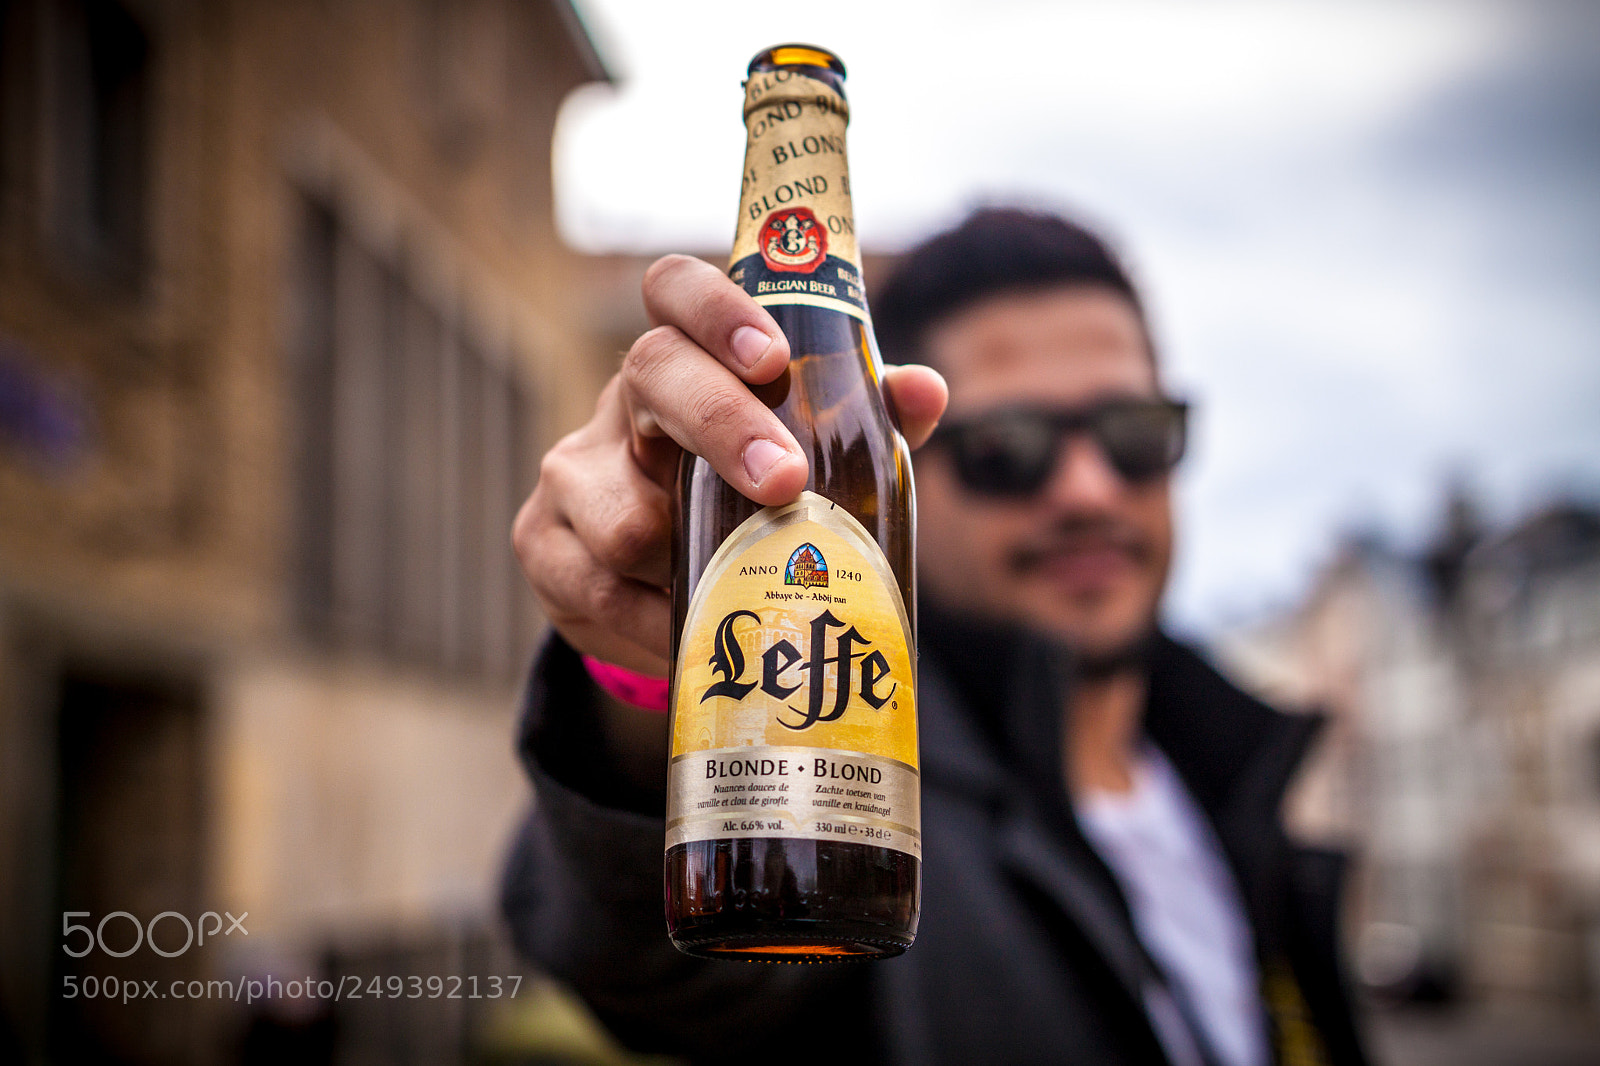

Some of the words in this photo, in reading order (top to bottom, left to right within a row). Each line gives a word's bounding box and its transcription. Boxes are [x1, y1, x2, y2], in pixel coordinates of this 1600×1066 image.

[748, 175, 828, 220] BLOND
[757, 280, 807, 293] BELGIAN
[809, 280, 837, 297] BEER
[739, 565, 778, 576] ANNO
[836, 569, 862, 582] 1240
[764, 591, 793, 602] Abbaye
[794, 592, 804, 600] de
[811, 592, 832, 604] Abdij
[834, 596, 847, 604] van
[700, 608, 897, 730] Leffe
[705, 759, 789, 779] BLONDE
[813, 758, 882, 784] BLOND
[713, 784, 745, 794] Nuances
[747, 783, 776, 792] douces
[778, 782, 790, 792] de
[815, 784, 844, 795] Zachte
[846, 788, 872, 799] toetsen
[873, 793, 886, 801] van
[697, 797, 720, 809] vanille
[721, 798, 729, 807] et
[730, 796, 747, 806] clou
[749, 796, 760, 806] de
[761, 796, 789, 808] girofle
[812, 798, 841, 807] vanille
[843, 802, 853, 810] en
[855, 801, 891, 817] kruidnagel
[722, 821, 739, 832] Alc.
[740, 820, 764, 831] 6,6%
[767, 820, 784, 831] vol.
[815, 822, 832, 833] 330
[834, 823, 846, 834] ml
[865, 827, 875, 838] 33
